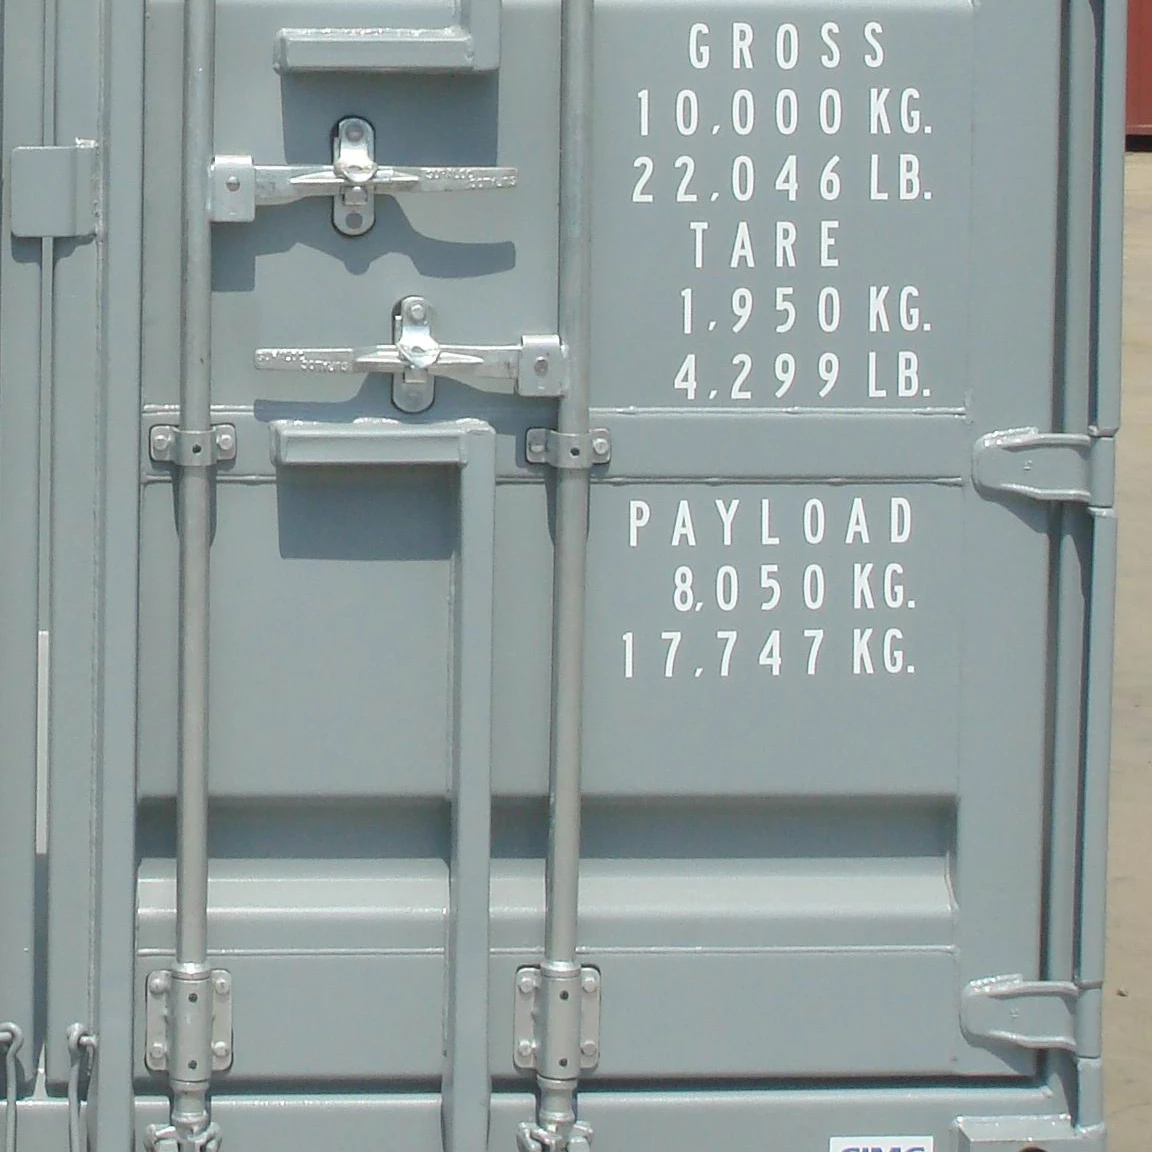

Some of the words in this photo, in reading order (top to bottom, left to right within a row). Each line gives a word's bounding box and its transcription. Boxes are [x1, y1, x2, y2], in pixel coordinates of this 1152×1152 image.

[688, 21, 885, 70] GROSS
[869, 87, 933, 135] KG.
[631, 154, 842, 202] 22,046
[869, 153, 933, 201] LB.
[689, 220, 840, 269] TARE
[680, 285, 841, 335] 1,950
[868, 285, 932, 333] KG.
[673, 351, 840, 400] 4,299
[867, 350, 931, 398] LB.
[628, 497, 913, 547] PAYLOAD
[672, 563, 826, 612] 8,050
[852, 562, 916, 610] KG.
[621, 628, 825, 678] 17,747
[852, 627, 916, 675] KG.
